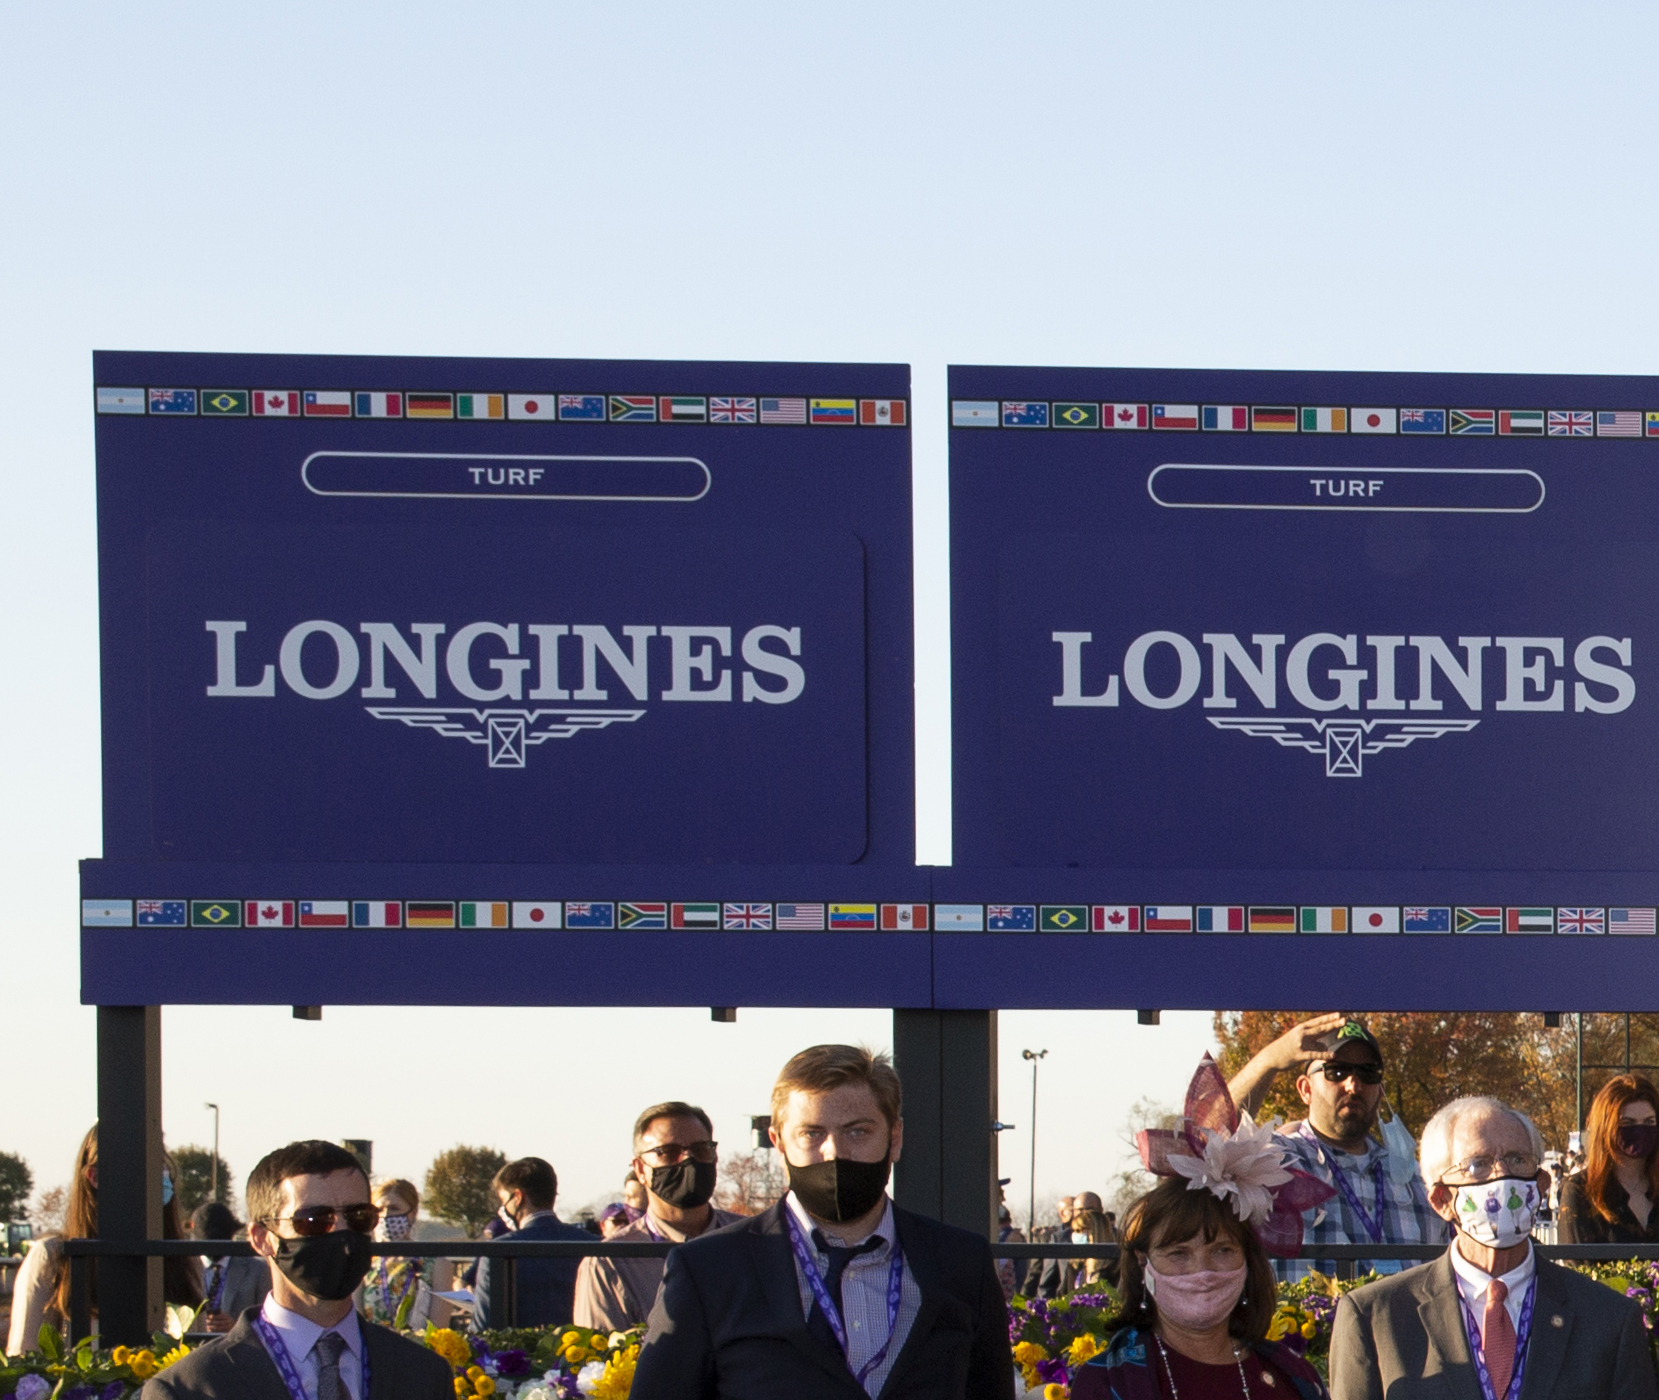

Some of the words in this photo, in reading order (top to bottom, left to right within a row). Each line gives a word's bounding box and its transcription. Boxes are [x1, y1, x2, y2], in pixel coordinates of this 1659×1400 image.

[469, 467, 546, 487] TURF
[1310, 479, 1385, 498] TURF
[206, 620, 805, 705] LONGINES
[1052, 629, 1636, 714] LONGINES
